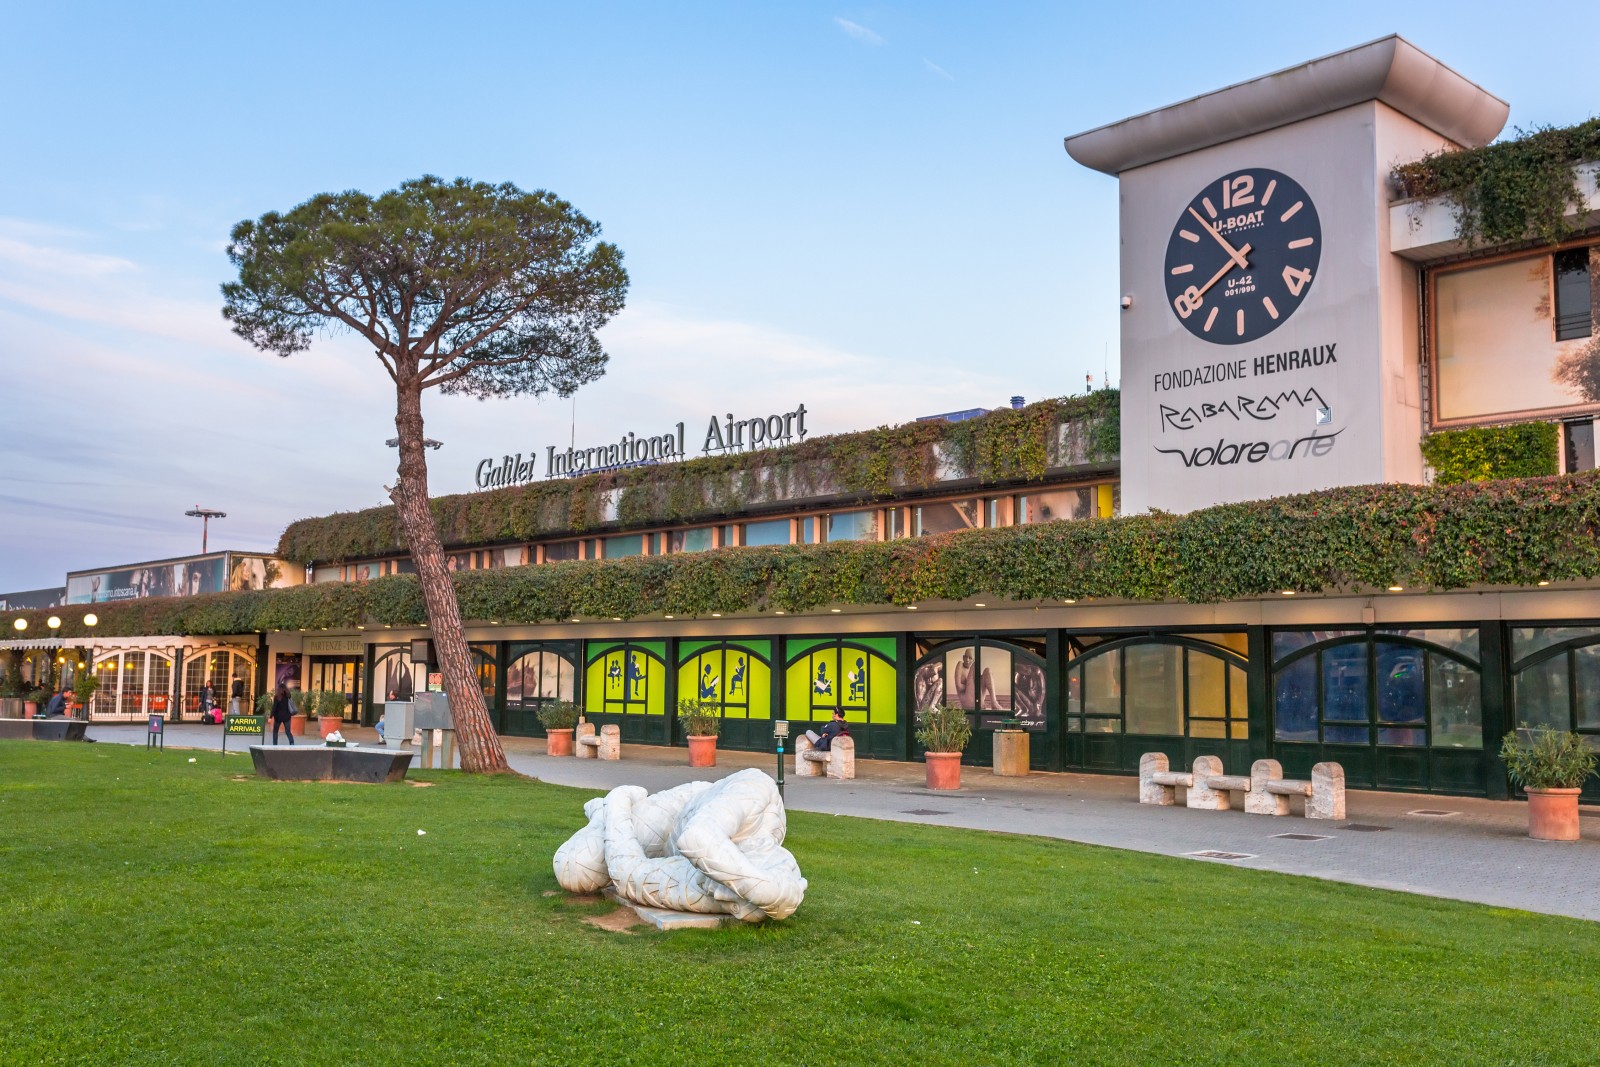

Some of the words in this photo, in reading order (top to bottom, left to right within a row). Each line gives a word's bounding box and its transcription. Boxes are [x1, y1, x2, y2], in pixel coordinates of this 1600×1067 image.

[1222, 175, 1255, 210] 12
[1212, 209, 1265, 232] U-BOAT
[1224, 284, 1256, 297] 001/999
[1227, 275, 1253, 288] U-42
[1282, 265, 1312, 297] 4
[1174, 285, 1203, 319] 8
[1154, 359, 1247, 392] FONDAZIONE
[1253, 343, 1337, 377] HENRAUX
[475, 452, 536, 489] Galilei
[545, 421, 685, 478] International
[702, 403, 808, 452] Airport
[310, 640, 342, 651] PARTENZE
[229, 725, 261, 733] ARRIVALS
